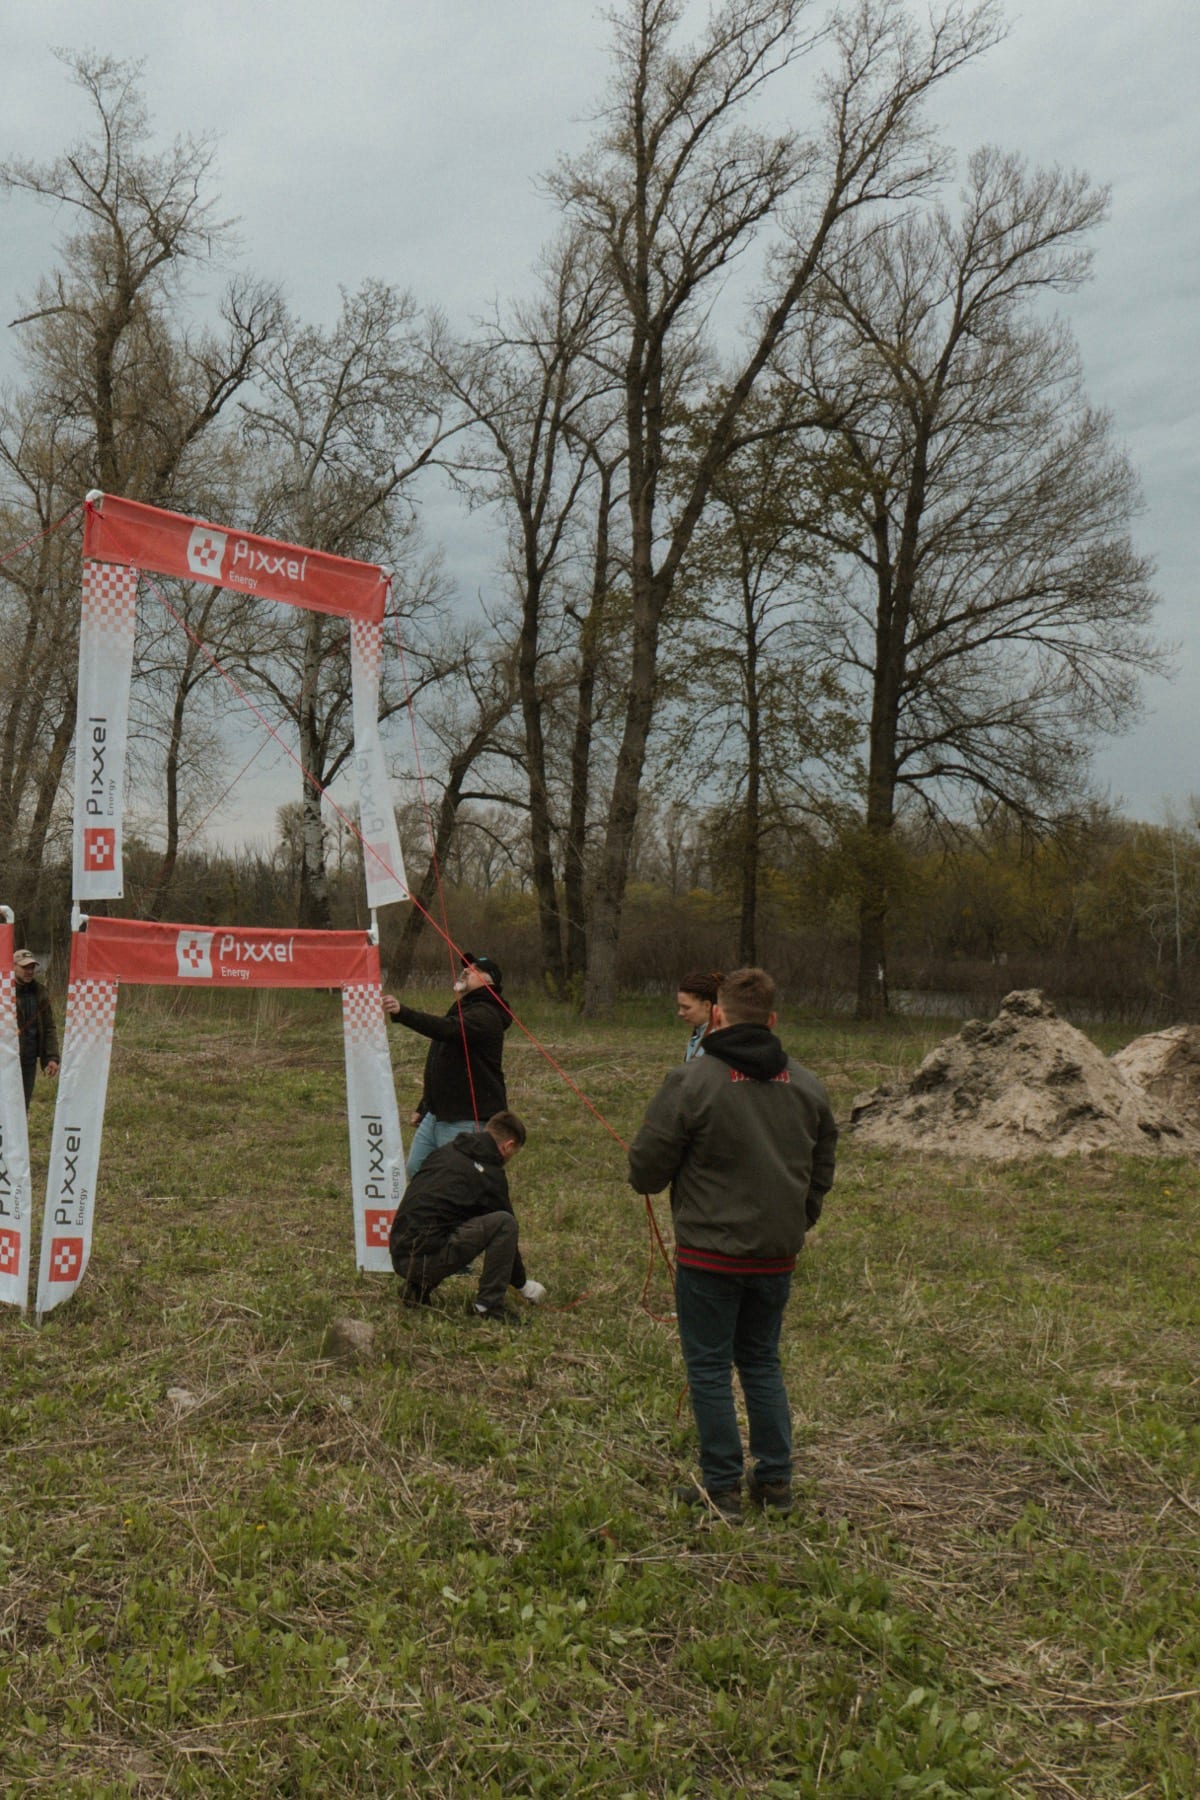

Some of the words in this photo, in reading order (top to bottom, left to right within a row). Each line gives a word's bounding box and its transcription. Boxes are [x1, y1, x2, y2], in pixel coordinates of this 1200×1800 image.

[232, 539, 308, 581] Pixxel
[229, 570, 258, 590] Energy
[86, 718, 107, 815] Pixxel
[107, 779, 116, 816] Energy
[219, 934, 295, 963] Pixxel
[221, 966, 250, 981] Energy
[361, 1115, 386, 1199] Pixxel
[54, 1127, 81, 1225] Pixxel
[391, 1166, 400, 1200] Energy
[76, 1188, 88, 1226] Energy
